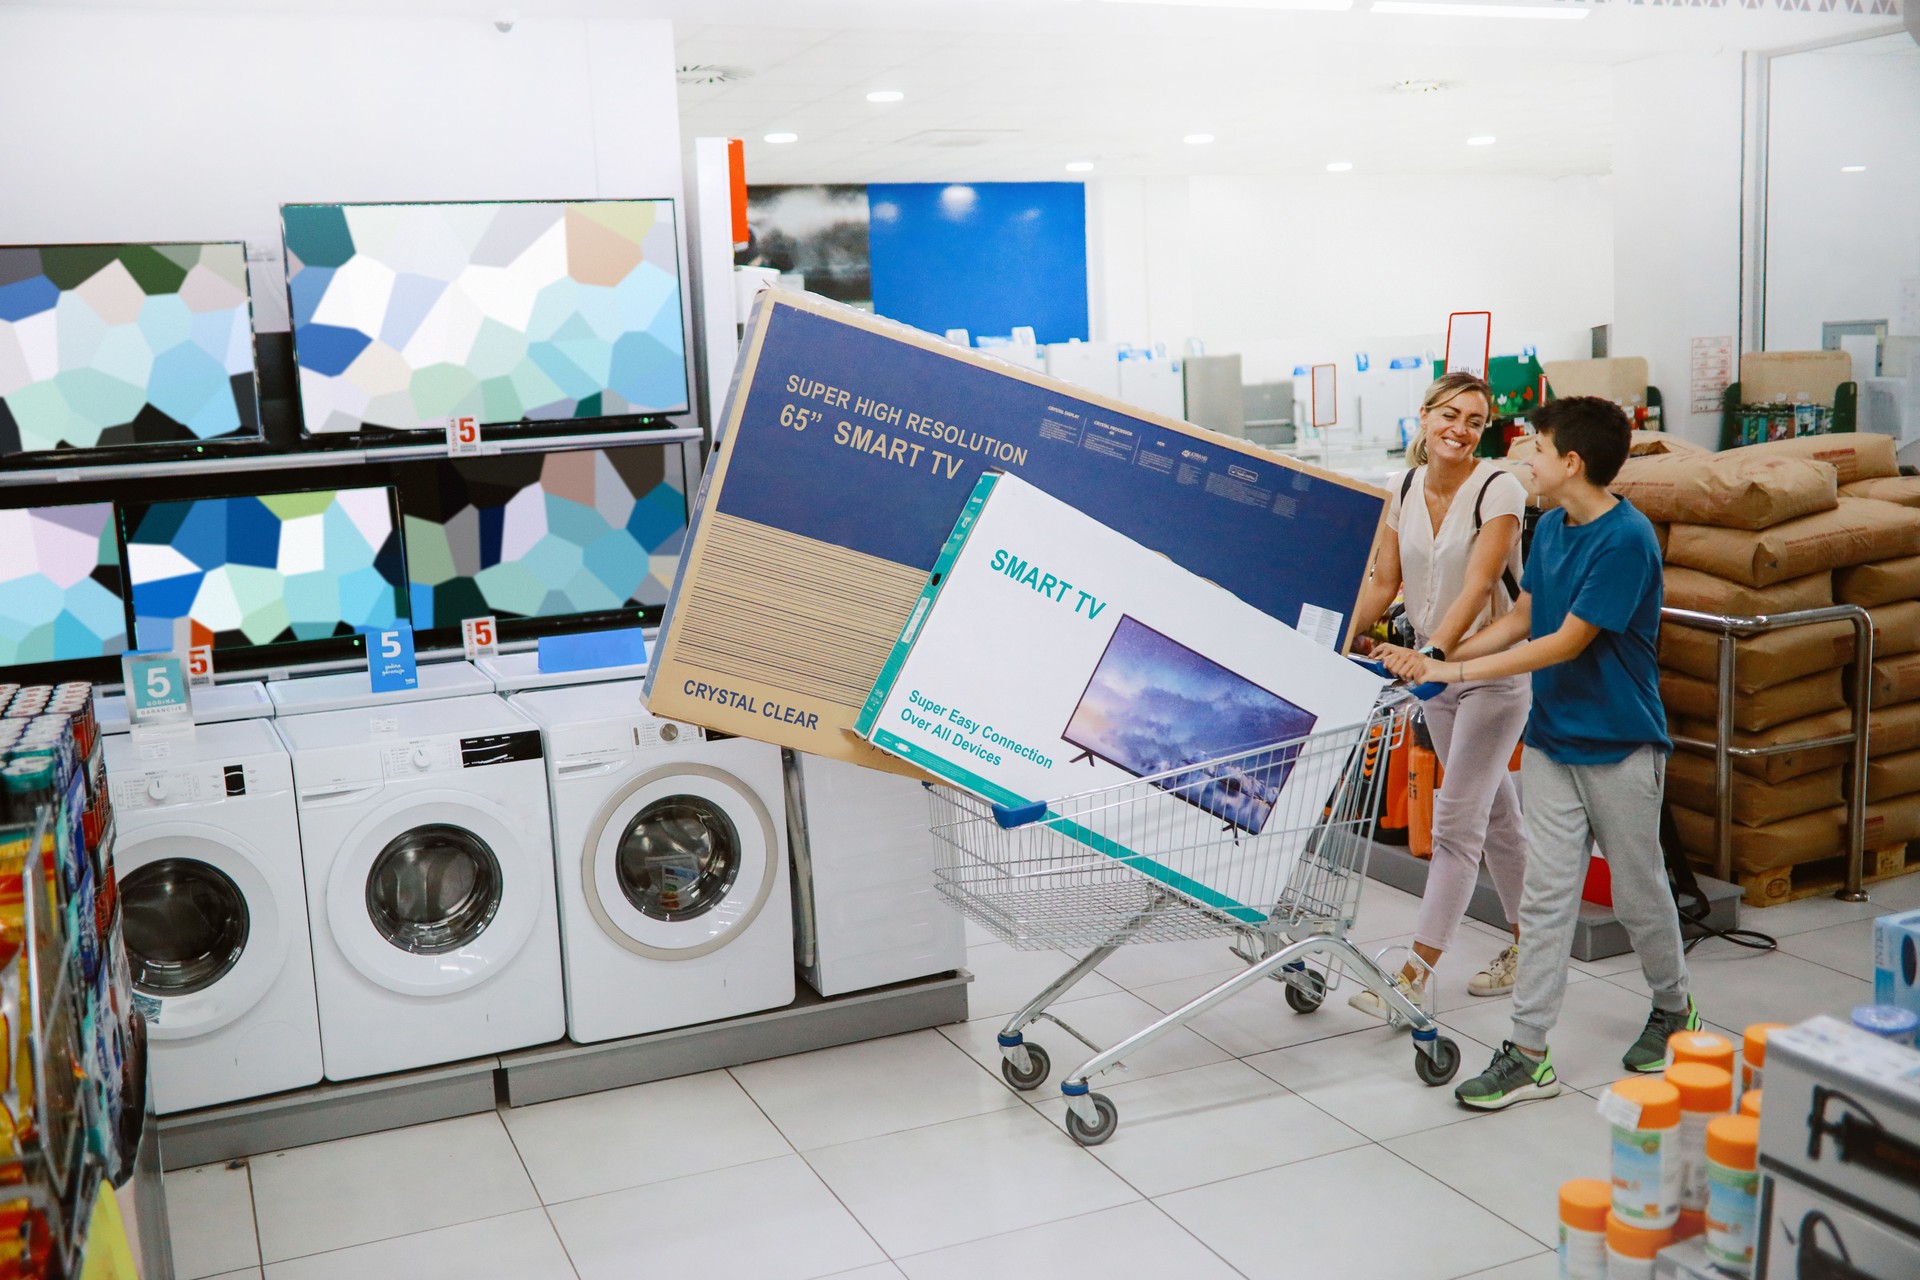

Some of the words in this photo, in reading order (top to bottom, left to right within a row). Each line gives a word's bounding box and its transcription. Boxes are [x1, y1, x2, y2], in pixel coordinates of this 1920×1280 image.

[459, 418, 476, 443] 5
[786, 374, 851, 409] SUPER
[854, 396, 903, 426] HIGH
[905, 413, 1028, 467] RESOLUTION
[833, 421, 925, 469] SMART
[931, 451, 964, 480] TV
[990, 549, 1073, 606] SMART
[1076, 590, 1107, 621] TV
[381, 631, 402, 659] 5
[475, 621, 492, 646] 5
[189, 649, 208, 675] 5
[146, 667, 171, 698] 5
[140, 706, 183, 716] GARANCIJE
[146, 699, 176, 707] GODINA
[683, 679, 757, 713] CRYSTAL
[763, 701, 819, 731] CLEAR
[900, 708, 930, 731] Over
[931, 720, 951, 739] All
[952, 731, 1001, 768] Devices
[908, 688, 947, 719] Super
[949, 708, 978, 735] Easy
[981, 723, 1054, 770] Connection
